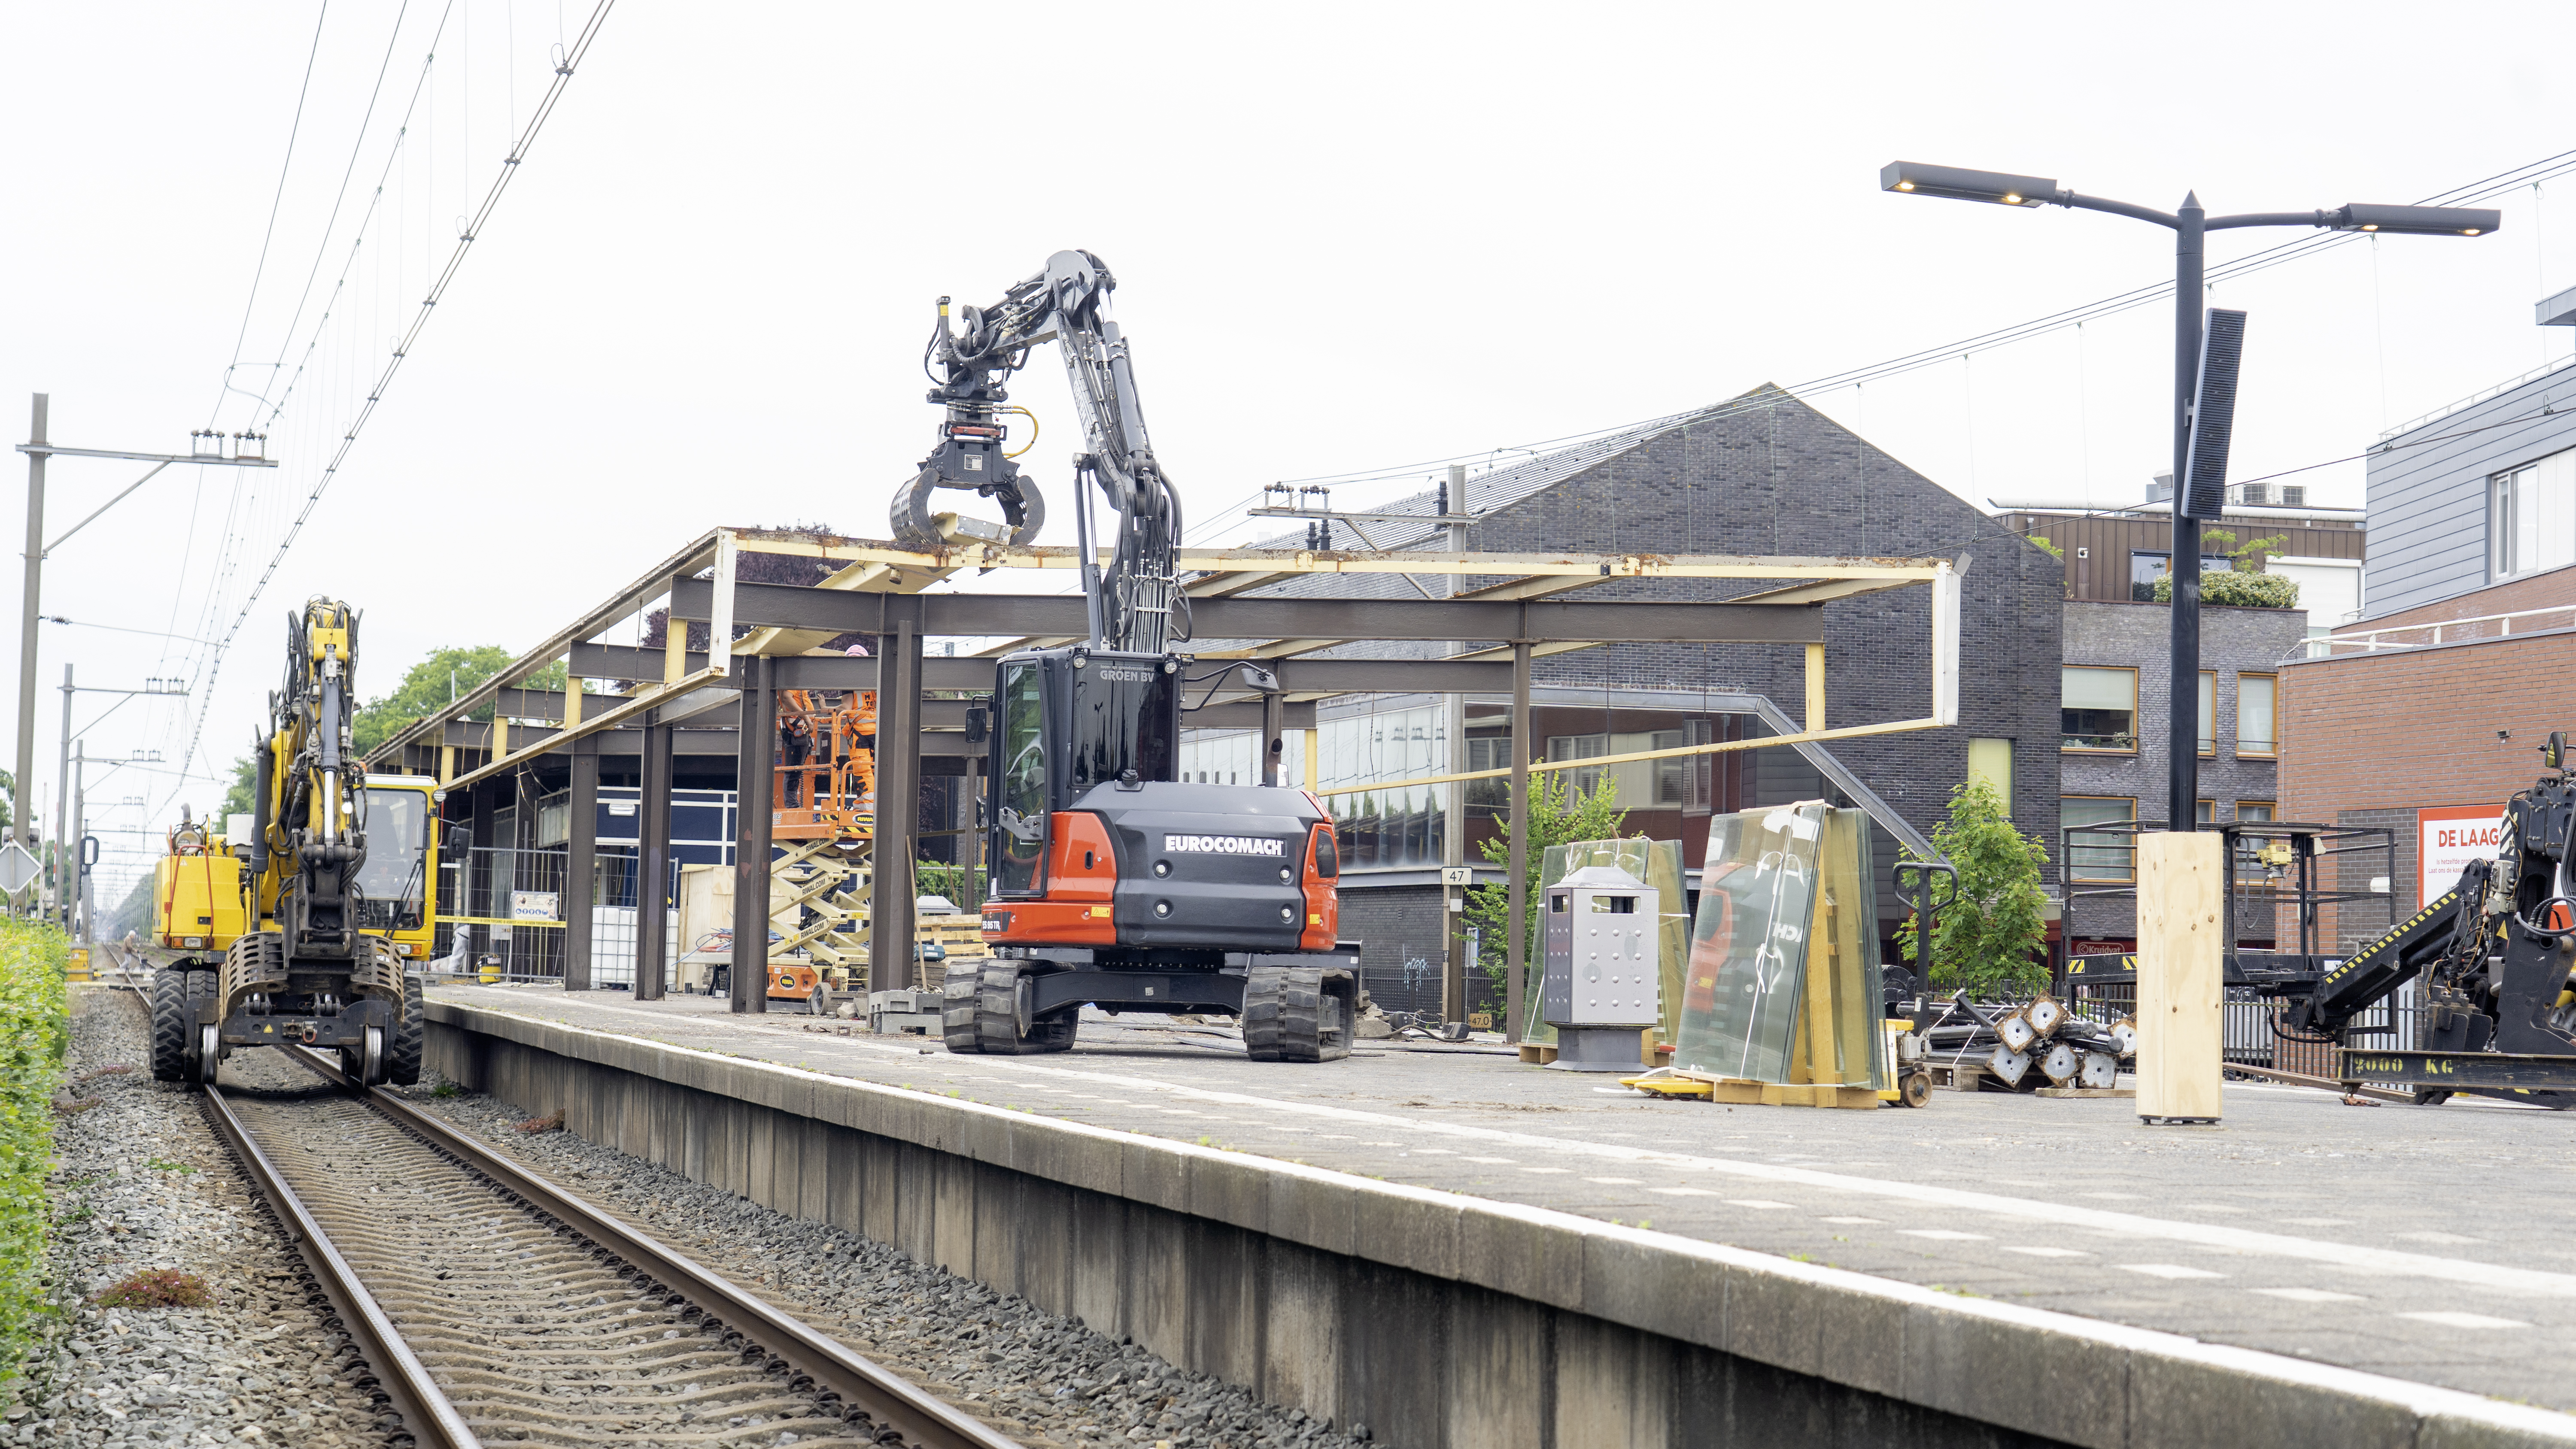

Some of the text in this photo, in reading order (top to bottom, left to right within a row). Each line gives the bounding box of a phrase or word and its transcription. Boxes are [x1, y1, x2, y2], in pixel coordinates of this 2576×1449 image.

[1100, 670, 1154, 682] GROEN BV
[2439, 828, 2503, 847] DE LAAG
[1166, 836, 1282, 855] EUROCOMACH
[1449, 871, 1464, 882] 47
[2089, 946, 2120, 954] Kruidvat
[1472, 1016, 1489, 1025] 47.0
[2426, 1058, 2454, 1074] KG
